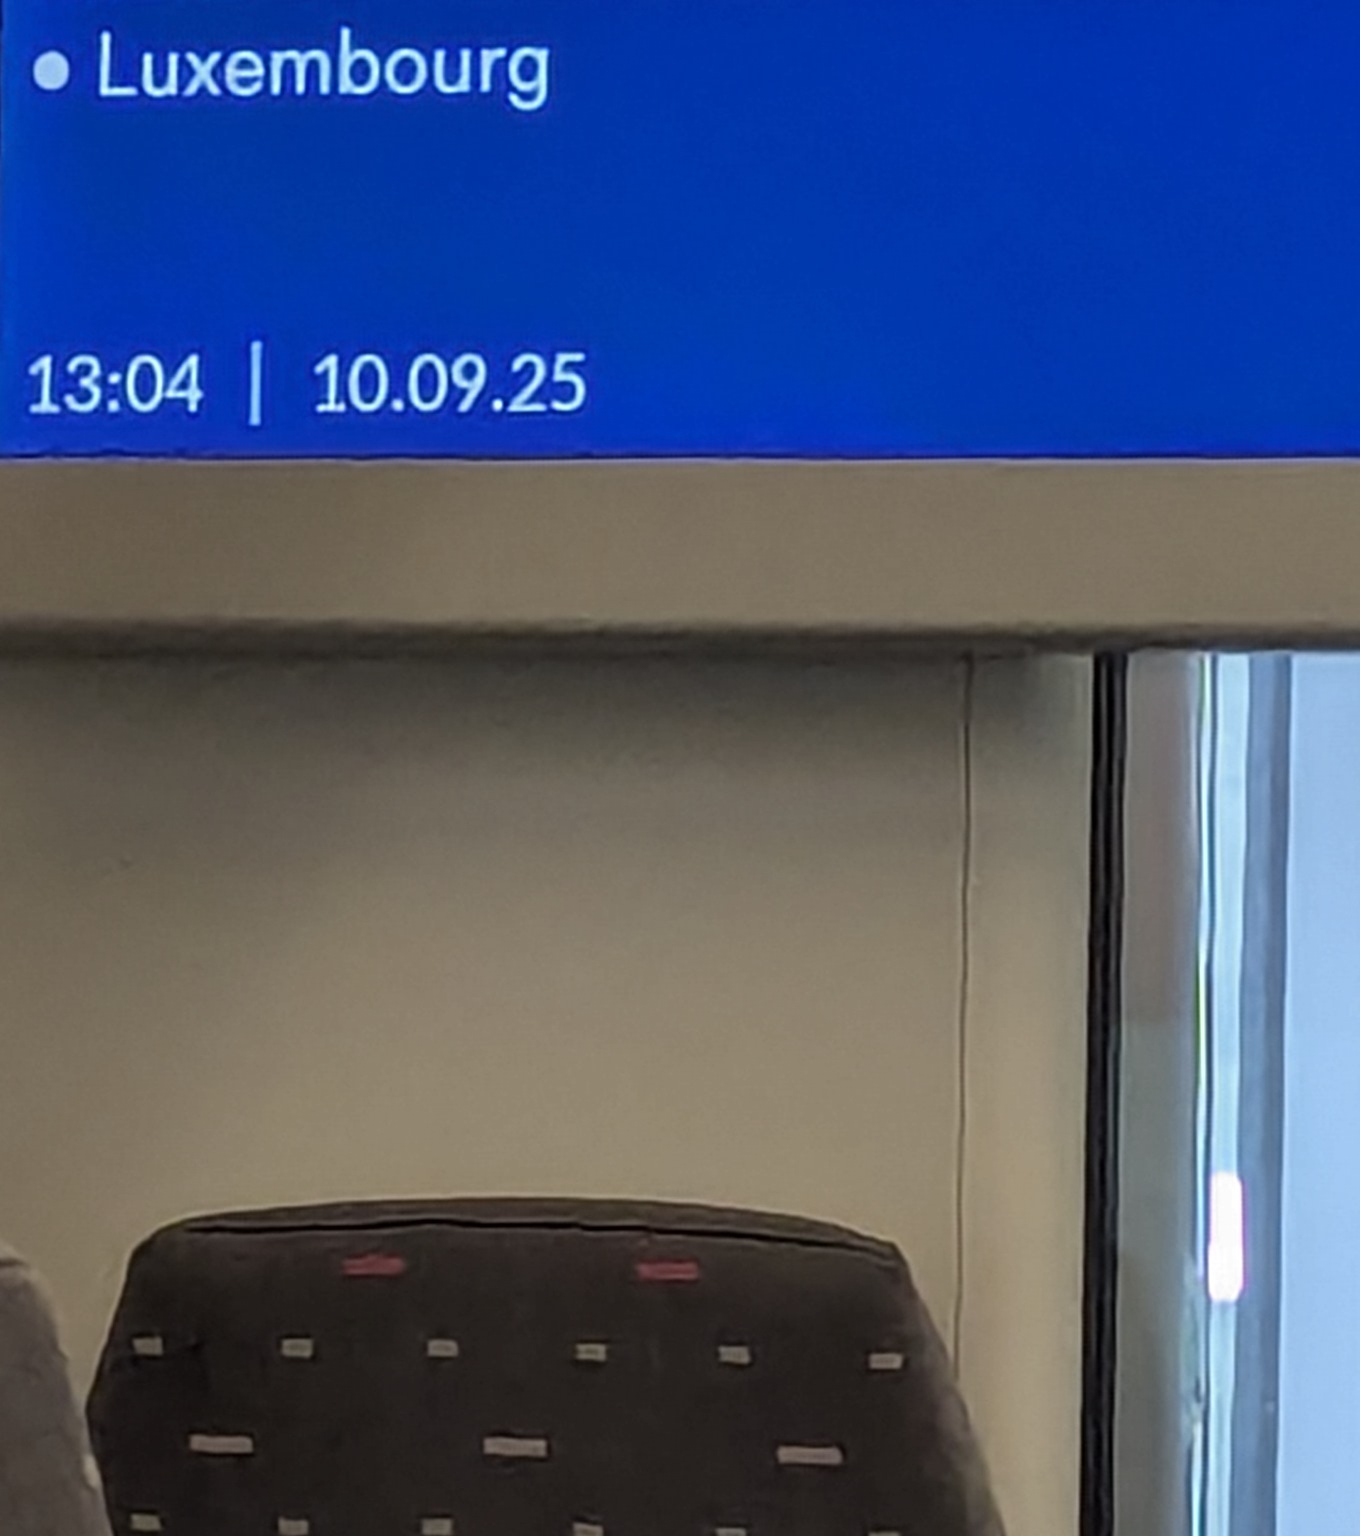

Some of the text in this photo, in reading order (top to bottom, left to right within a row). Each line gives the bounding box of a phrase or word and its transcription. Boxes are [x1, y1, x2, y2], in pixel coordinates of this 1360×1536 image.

[98, 26, 549, 111] Luxembourg
[28, 353, 204, 415] 13:04
[314, 352, 588, 414] 10.09.25
